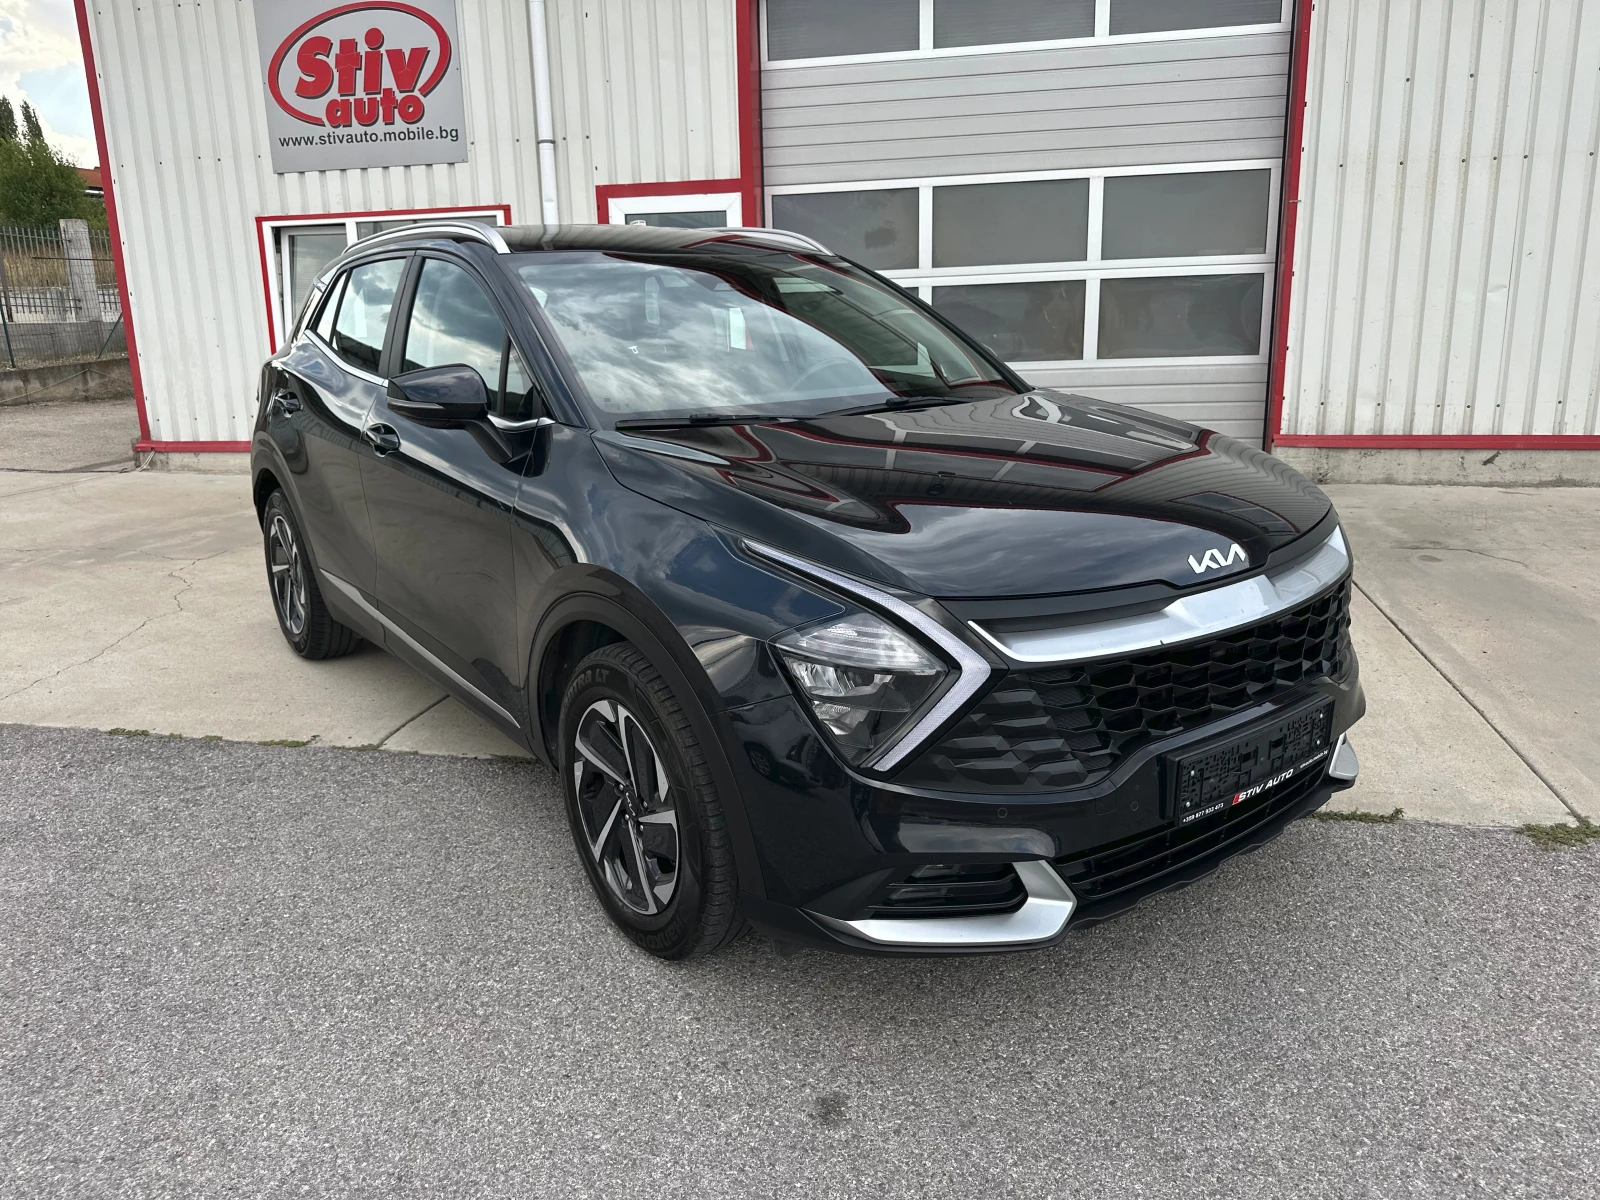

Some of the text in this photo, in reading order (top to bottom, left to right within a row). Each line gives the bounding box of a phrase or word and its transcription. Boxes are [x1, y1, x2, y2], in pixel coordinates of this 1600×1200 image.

[295, 27, 430, 97] Stiv
[325, 87, 425, 128] auto
[278, 126, 459, 147] www.stivauto.mobile.bg
[1238, 768, 1294, 802] STIV AUTO
